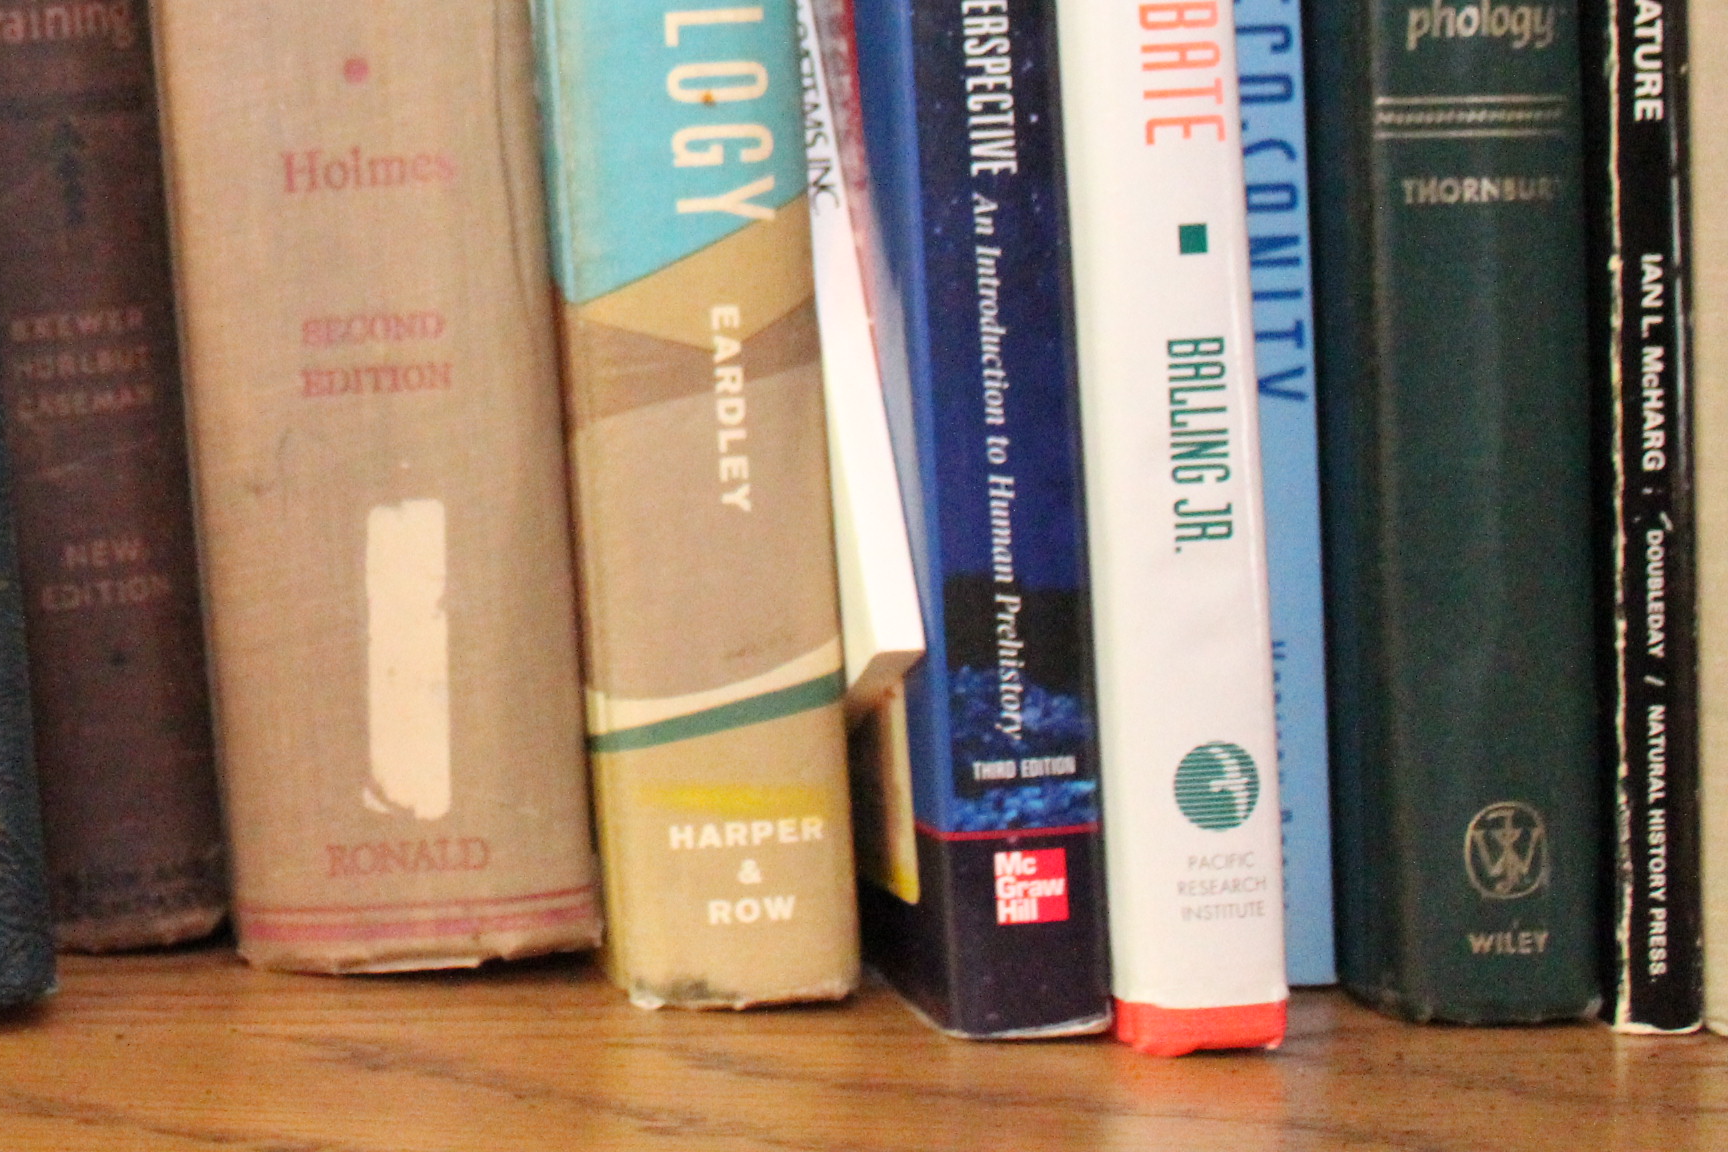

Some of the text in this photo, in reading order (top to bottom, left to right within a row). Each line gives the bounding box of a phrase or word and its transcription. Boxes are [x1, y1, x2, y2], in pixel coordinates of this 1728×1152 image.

[280, 145, 458, 194] Holmes
[1402, 175, 1560, 205] THORNBUR
[1640, 253, 1663, 307] IAN
[300, 361, 454, 398] EDITION
[711, 303, 753, 513] EARDLEY
[1640, 346, 1666, 472] McHARG
[1166, 335, 1233, 555] BALLING JR.
[972, 192, 1025, 740] An Introduction to Human Prehistory
[1645, 529, 1666, 656] DOUBLEDAY
[1646, 704, 1668, 805] NATURAL
[668, 815, 825, 850] HARPER
[325, 836, 491, 878] RONALD
[737, 858, 762, 885] &
[994, 851, 1037, 876] Mc
[1188, 851, 1255, 871] PACIFIC
[1646, 809, 1668, 902] HISTORY
[995, 875, 1065, 899] Graw
[1178, 876, 1266, 896] RESEARCH
[708, 894, 796, 926] ROW
[997, 897, 1038, 923] Hill
[1181, 900, 1266, 922] INSTITUTE
[1468, 930, 1550, 955] WILEY
